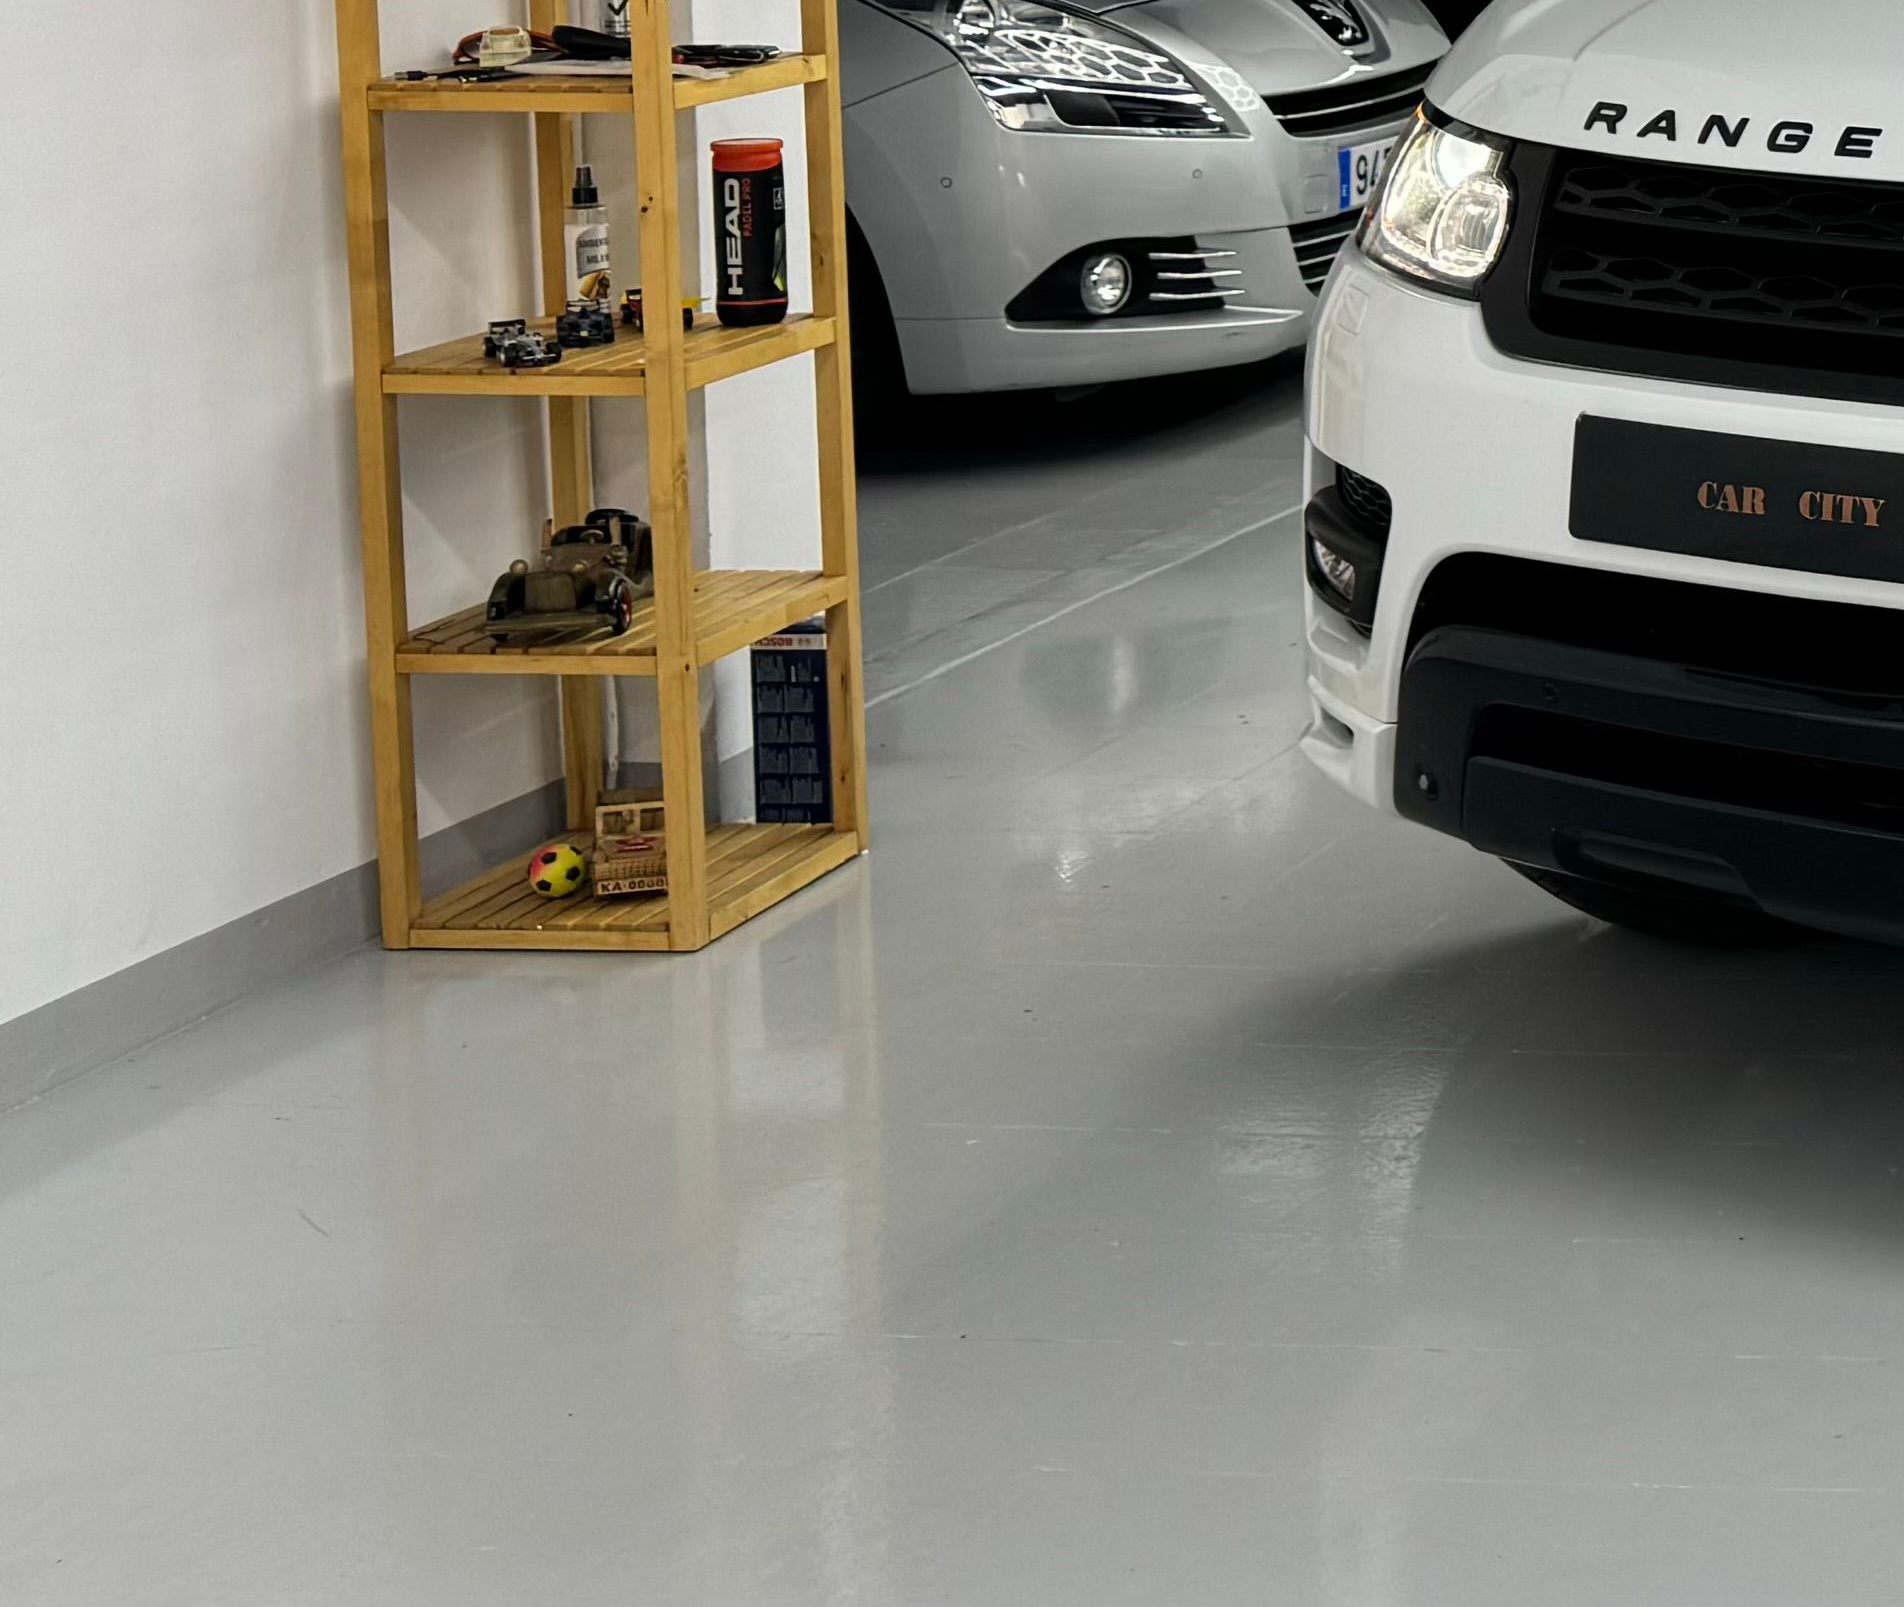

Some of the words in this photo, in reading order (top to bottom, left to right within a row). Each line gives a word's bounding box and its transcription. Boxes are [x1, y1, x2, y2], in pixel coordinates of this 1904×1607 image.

[1583, 101, 1884, 159] RANGE
[741, 177, 752, 200] PRO
[1356, 147, 1393, 195] 94
[724, 177, 744, 296] HEAD
[742, 202, 752, 237] PADEL
[1697, 481, 1767, 516] CAR
[1798, 491, 1887, 528] CITY
